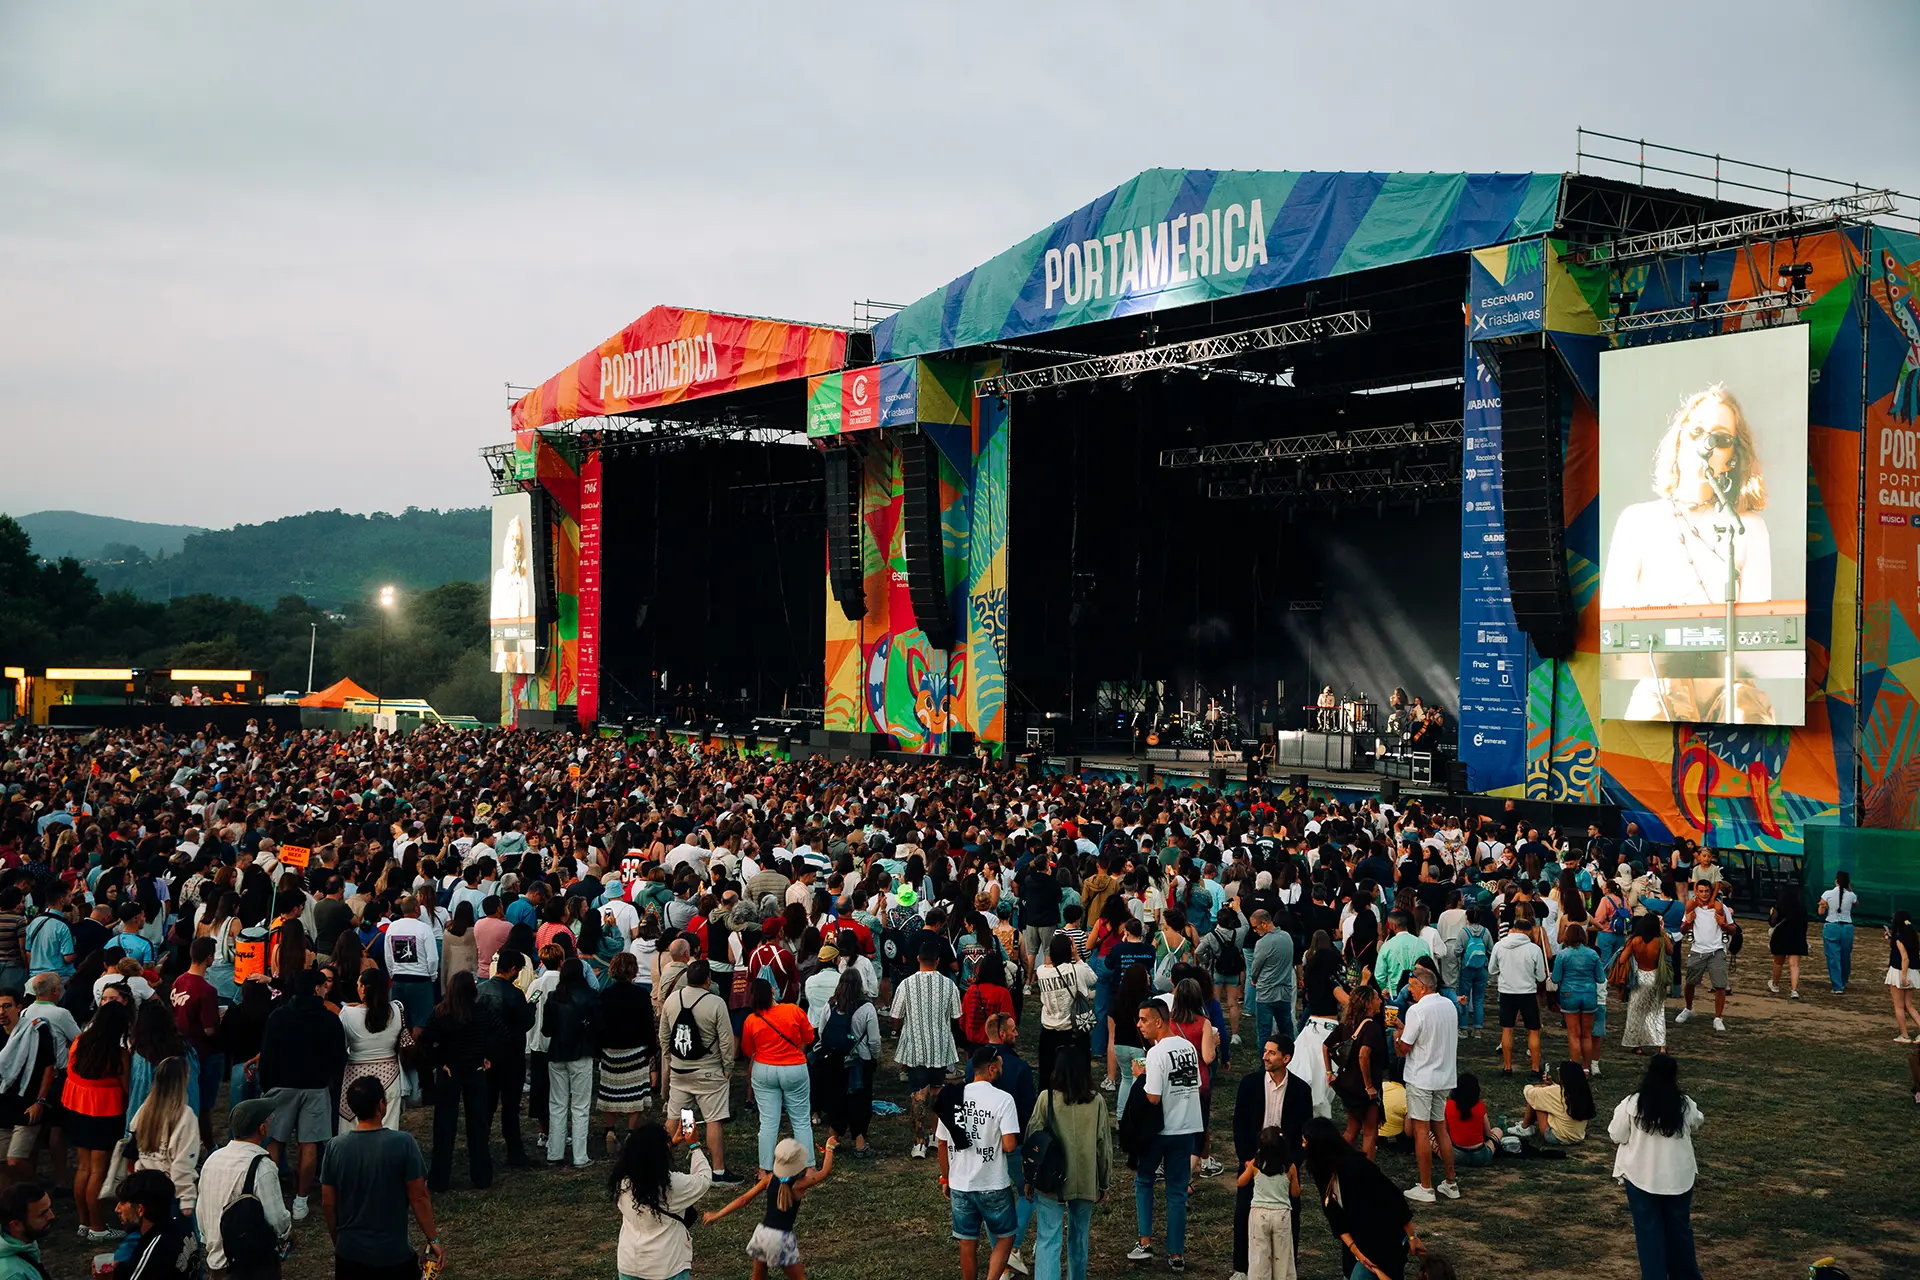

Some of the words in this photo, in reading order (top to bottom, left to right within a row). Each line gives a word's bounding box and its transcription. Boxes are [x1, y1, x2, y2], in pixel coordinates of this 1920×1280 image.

[1044, 199, 1268, 309] PORTAMÉRICA
[1481, 291, 1534, 308] ESCENARIO
[1489, 309, 1541, 326] riasbaixas
[600, 332, 717, 399] PORTAMÉRICA
[1471, 398, 1502, 410] ABANC
[1881, 515, 1905, 524] MÚSICA
[621, 858, 639, 883] 32
[1168, 1047, 1197, 1070] Ford
